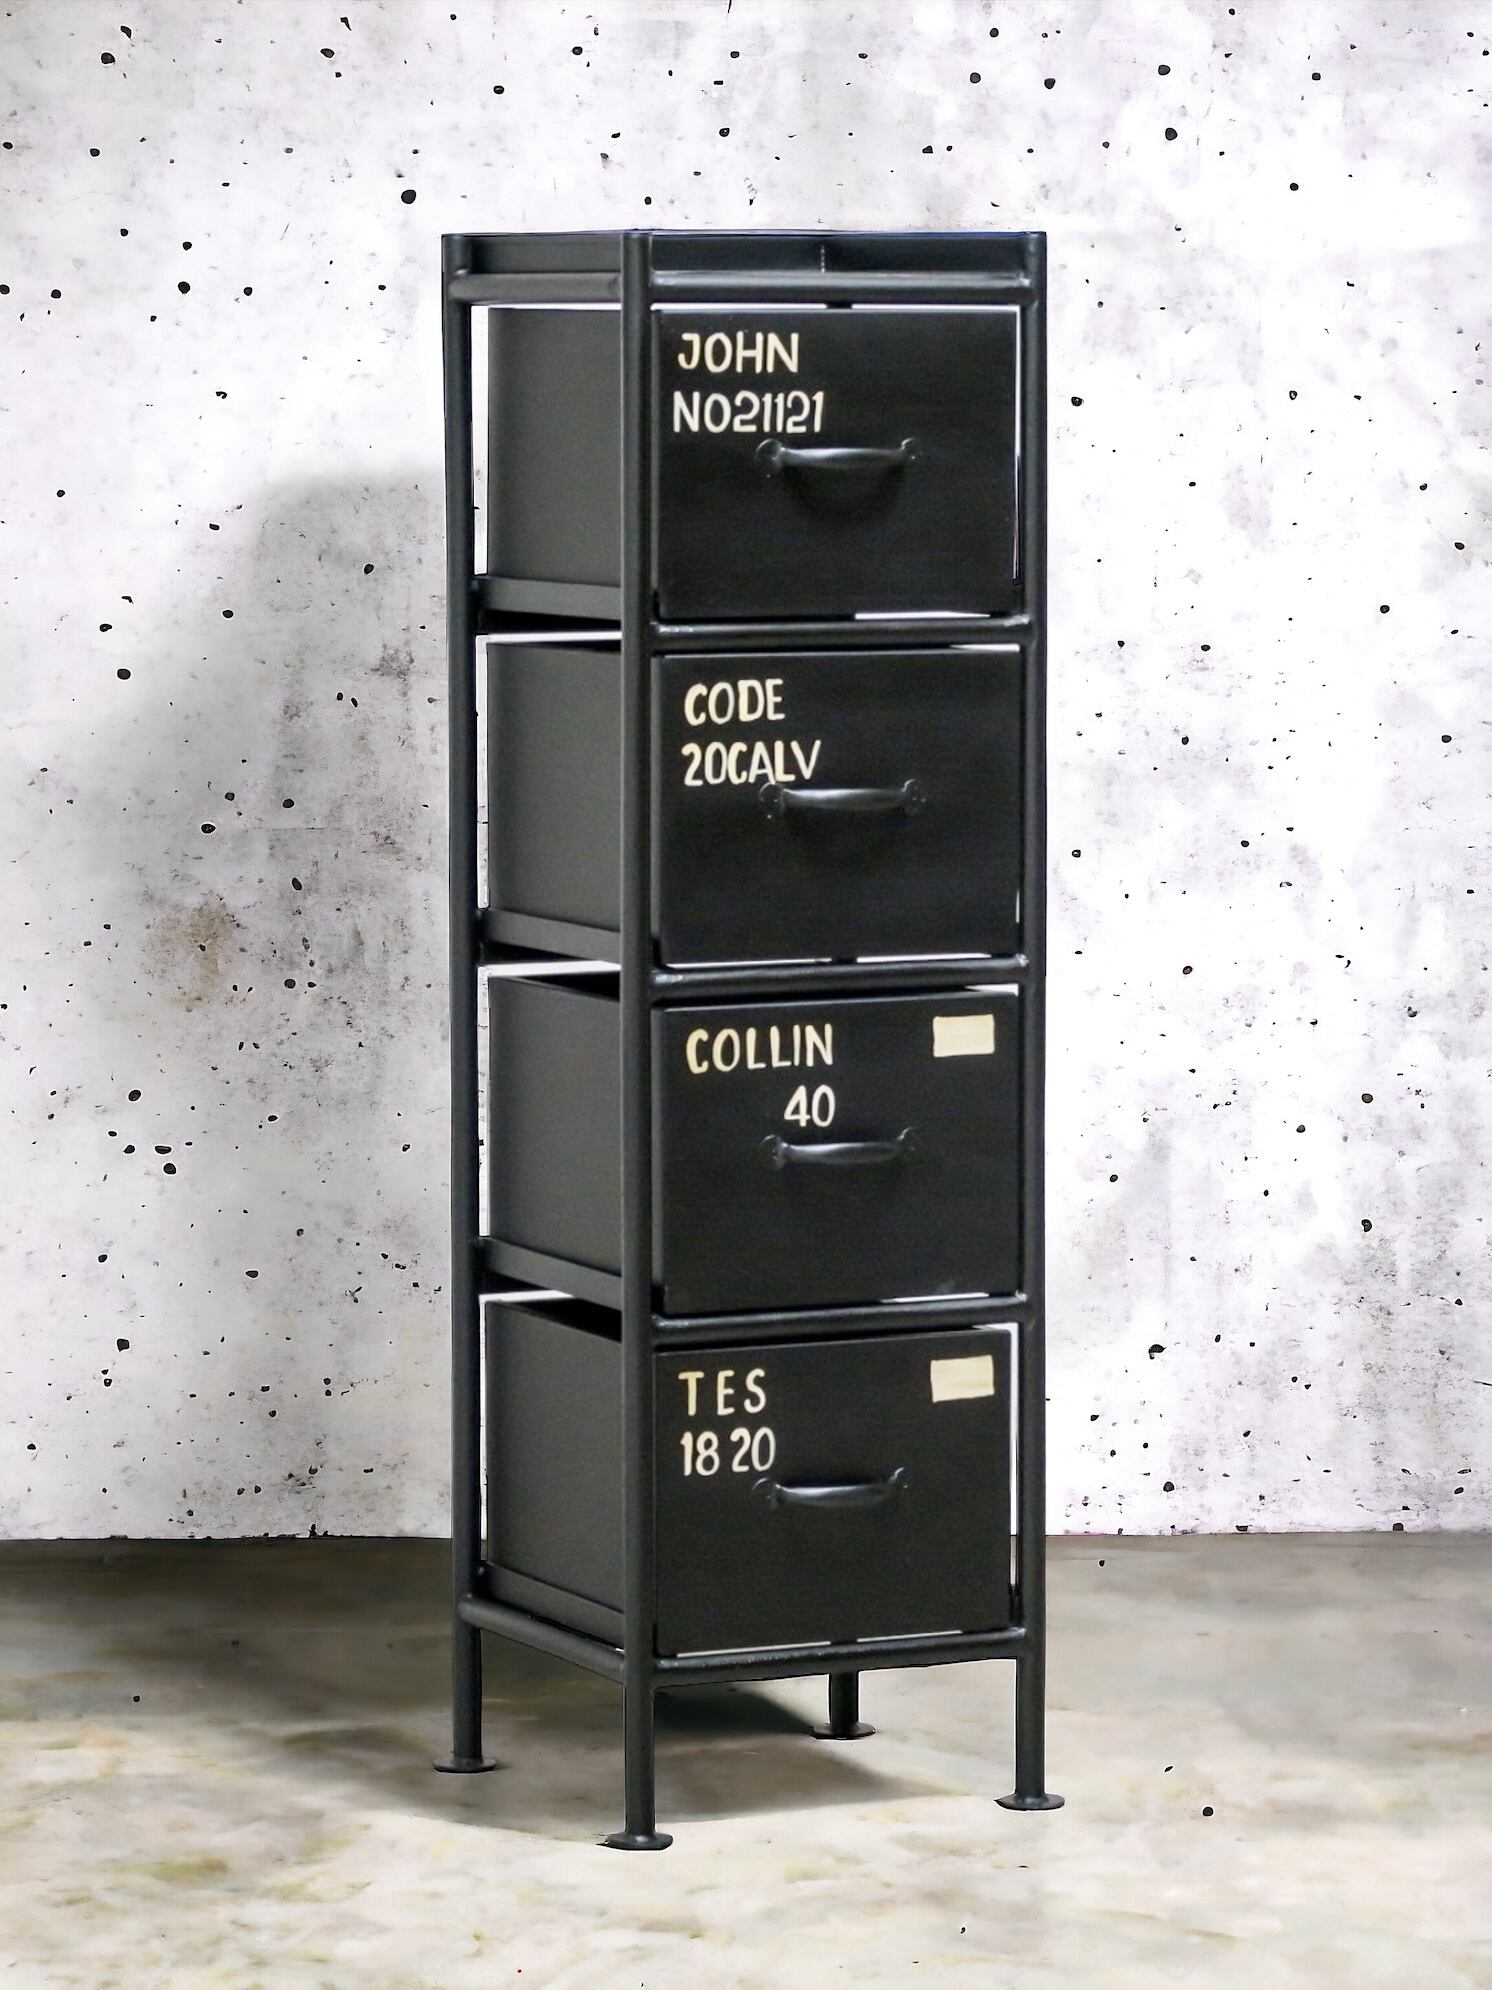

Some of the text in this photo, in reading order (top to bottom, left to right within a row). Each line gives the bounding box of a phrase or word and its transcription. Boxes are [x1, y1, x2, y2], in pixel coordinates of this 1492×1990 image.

[677, 331, 800, 374] JOHN
[684, 678, 786, 726] CODE
[680, 739, 822, 787] 20CALV
[685, 1023, 834, 1075] COLLIN
[783, 1084, 836, 1128] 40
